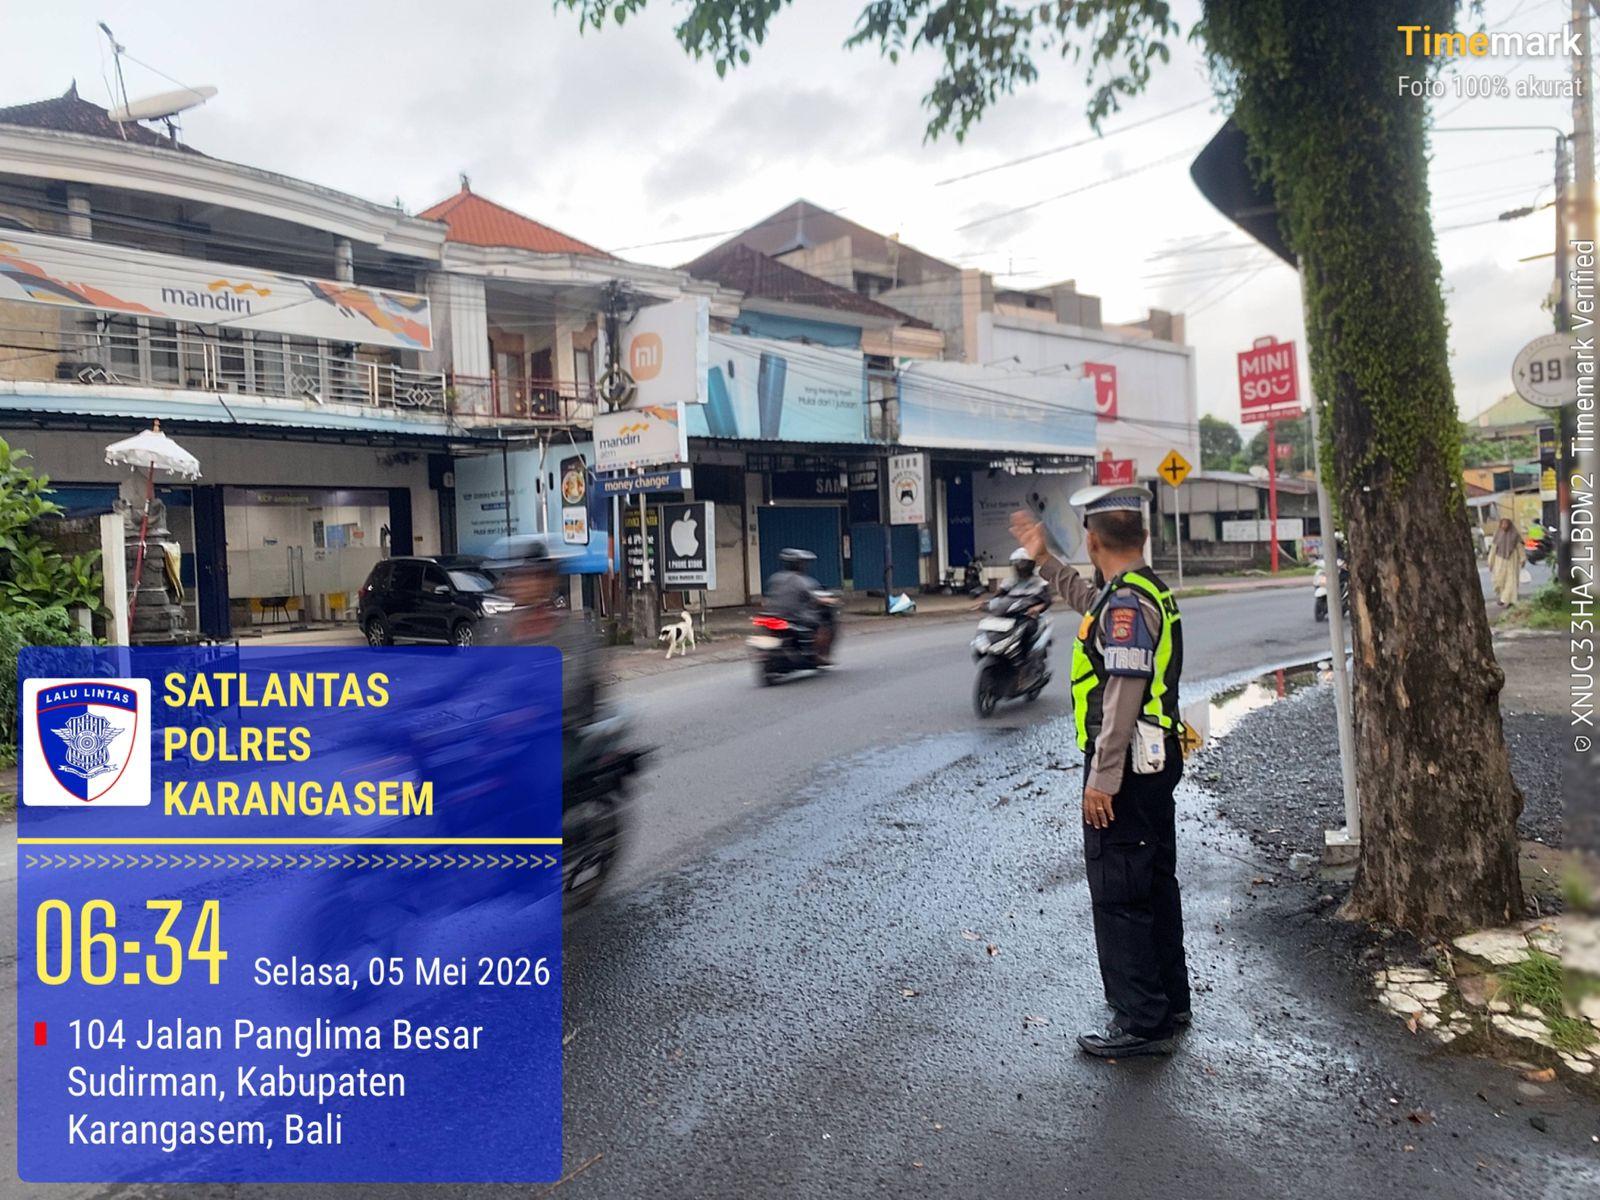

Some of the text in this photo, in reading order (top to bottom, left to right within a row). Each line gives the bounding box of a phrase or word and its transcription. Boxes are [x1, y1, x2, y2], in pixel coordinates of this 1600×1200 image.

[162, 287, 251, 315] mandiri
[1240, 350, 1290, 378] MINI
[599, 434, 640, 449] mandiri
[604, 475, 669, 492] money changer
[1104, 646, 1153, 672] TROLI
